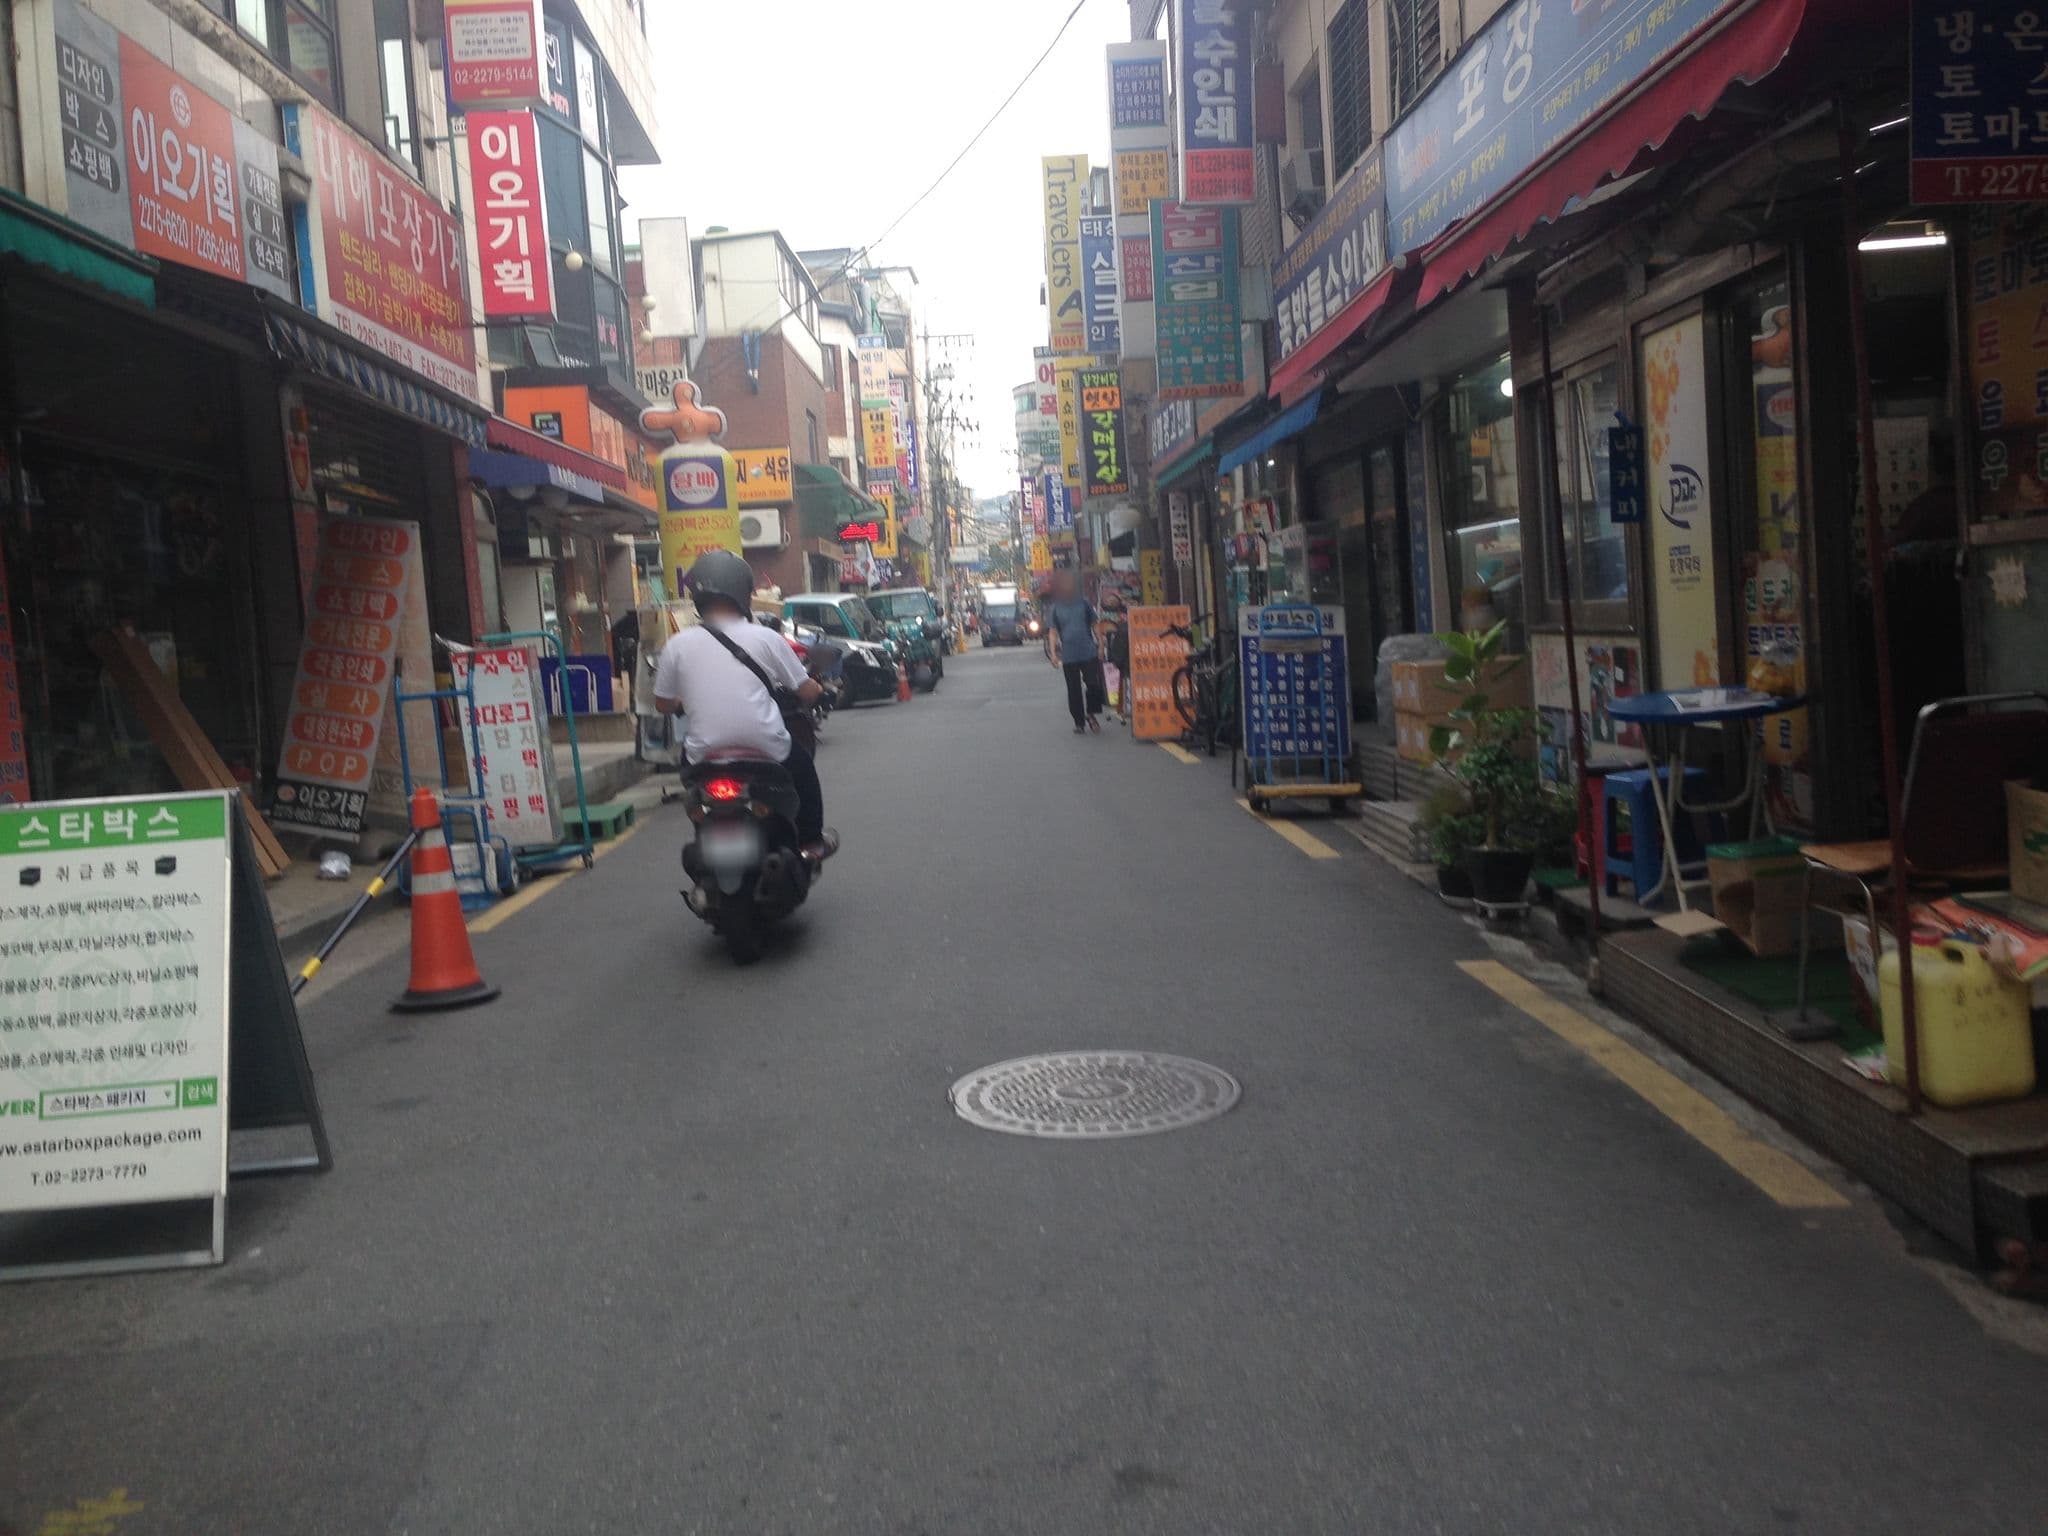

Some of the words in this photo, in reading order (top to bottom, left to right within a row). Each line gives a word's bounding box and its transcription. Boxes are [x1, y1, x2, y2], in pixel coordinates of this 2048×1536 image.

[62, 45, 106, 102] 디자인
[69, 142, 114, 189] 쇼핑백
[131, 106, 237, 238] 이오기획
[480, 124, 534, 301] 이오기획
[1047, 158, 1079, 290] Travelers
[255, 239, 285, 280] 현수막
[298, 784, 366, 820] 이오기획
[18, 806, 181, 849] 스타박스
[50, 1095, 104, 1113] 스타박스
